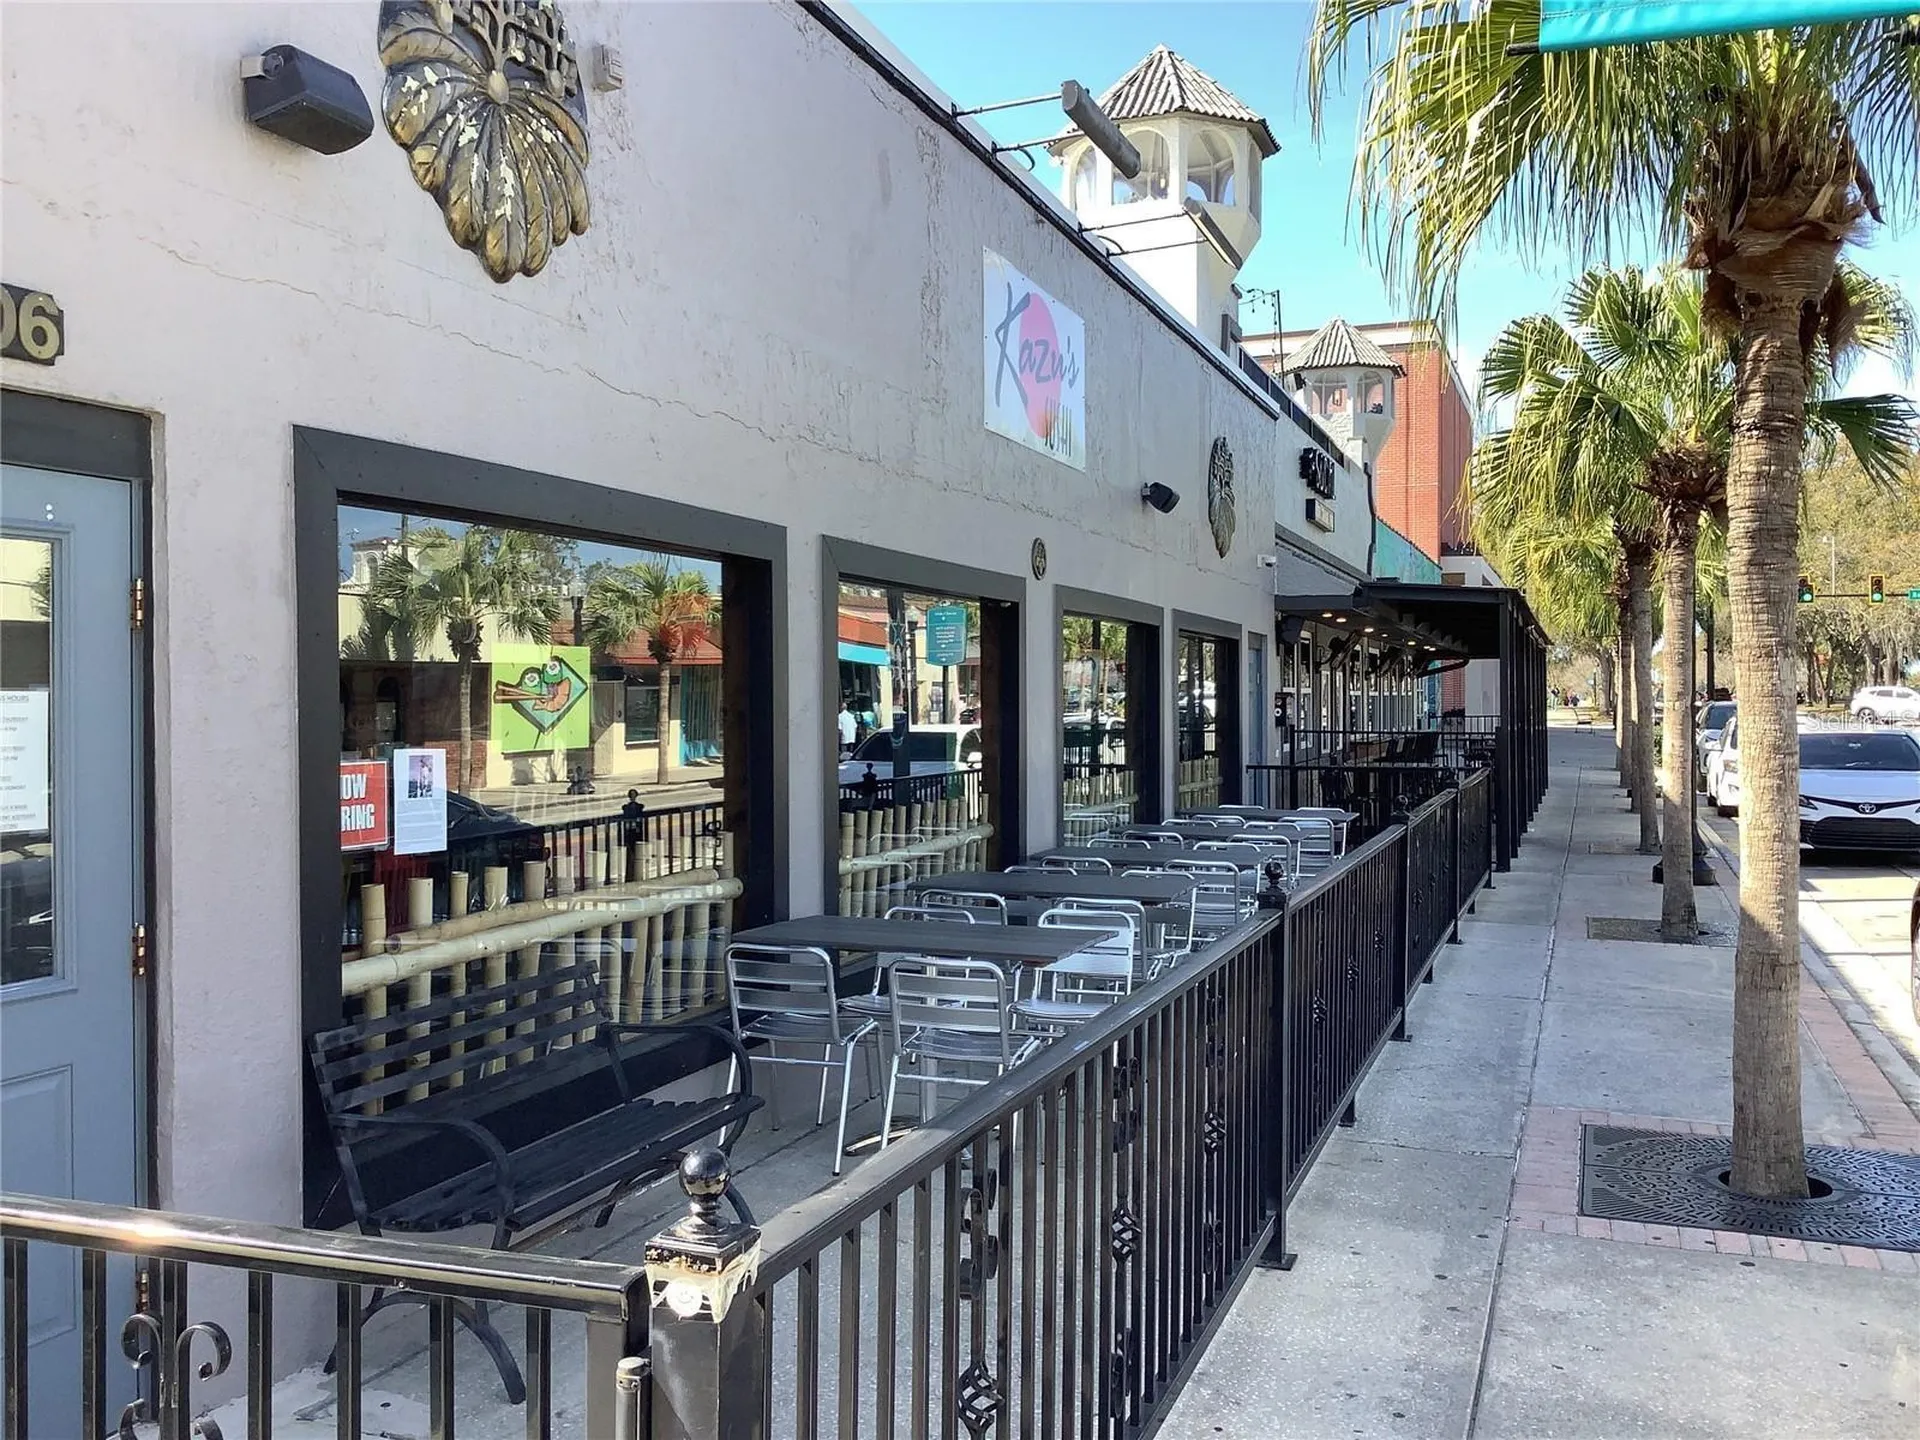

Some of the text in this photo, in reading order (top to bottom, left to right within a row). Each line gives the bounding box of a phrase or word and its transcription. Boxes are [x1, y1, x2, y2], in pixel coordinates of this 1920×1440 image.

[995, 281, 1079, 408] Kazu's
[340, 773, 367, 800] OW
[340, 804, 375, 832] RING
